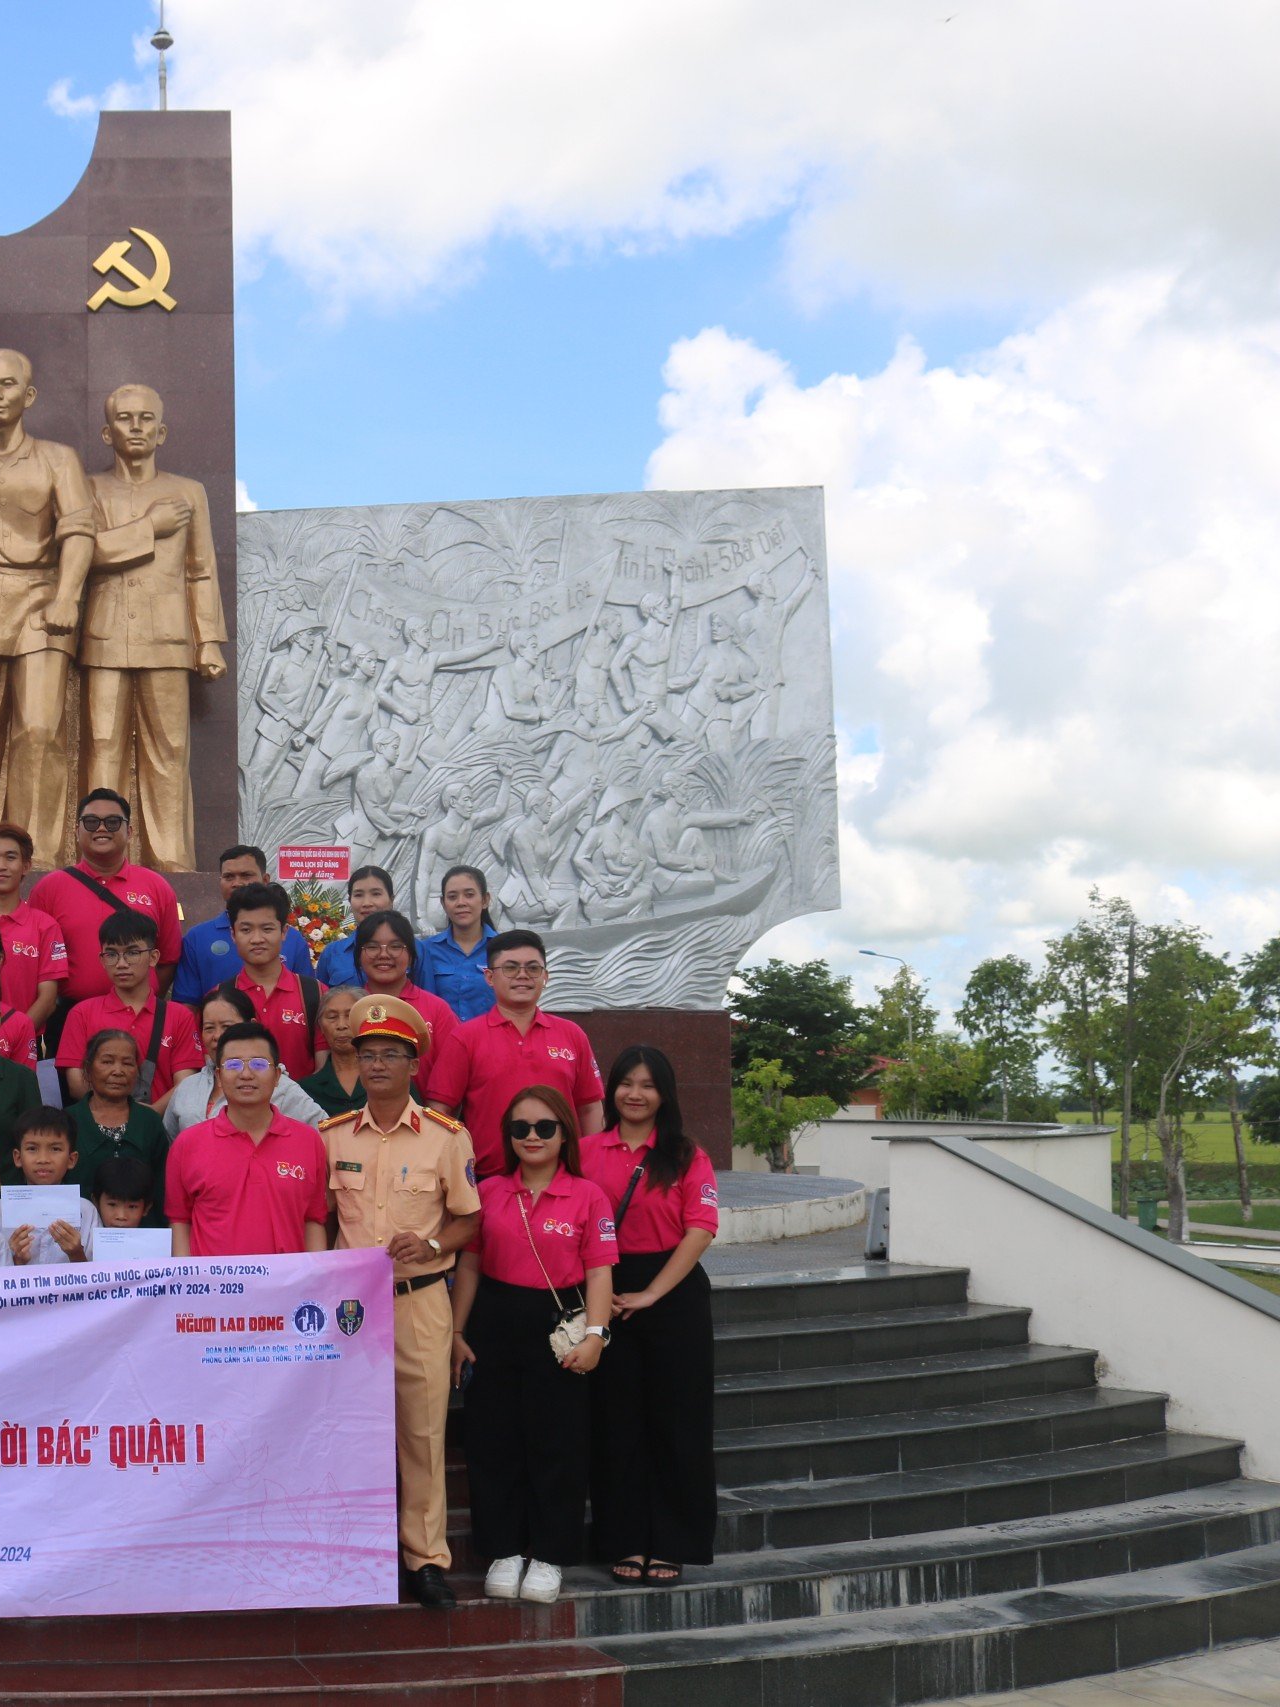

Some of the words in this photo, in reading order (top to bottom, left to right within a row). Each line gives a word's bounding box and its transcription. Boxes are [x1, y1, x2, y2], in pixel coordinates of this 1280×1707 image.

[305, 861, 316, 869] LỊCH
[317, 860, 324, 868] SỬ
[324, 860, 339, 868] ĐẢNG
[4, 1279, 17, 1290] RA
[20, 1278, 30, 1289] ĐI
[33, 1276, 51, 1288] TÌM
[54, 1274, 88, 1286] ĐƯỜNG
[91, 1272, 111, 1283] CỨU
[115, 1269, 141, 1282] NƯỚC
[145, 1266, 199, 1280] (05/6/1911
[210, 1265, 269, 1276] 05/6/2024);
[11, 1296, 35, 1307] LHTN
[38, 1293, 59, 1304] VIỆT
[63, 1292, 84, 1302] NAM
[88, 1289, 107, 1300] CÁC
[111, 1286, 132, 1299] CẤP,
[136, 1284, 166, 1298] NHIỆM
[170, 1282, 182, 1295] KỲ
[186, 1284, 210, 1295] 2024
[220, 1283, 244, 1294] 2029
[220, 1317, 245, 1332] LAO
[109, 1417, 187, 1475] QUẬN
[0, 1547, 32, 1562] 2024
